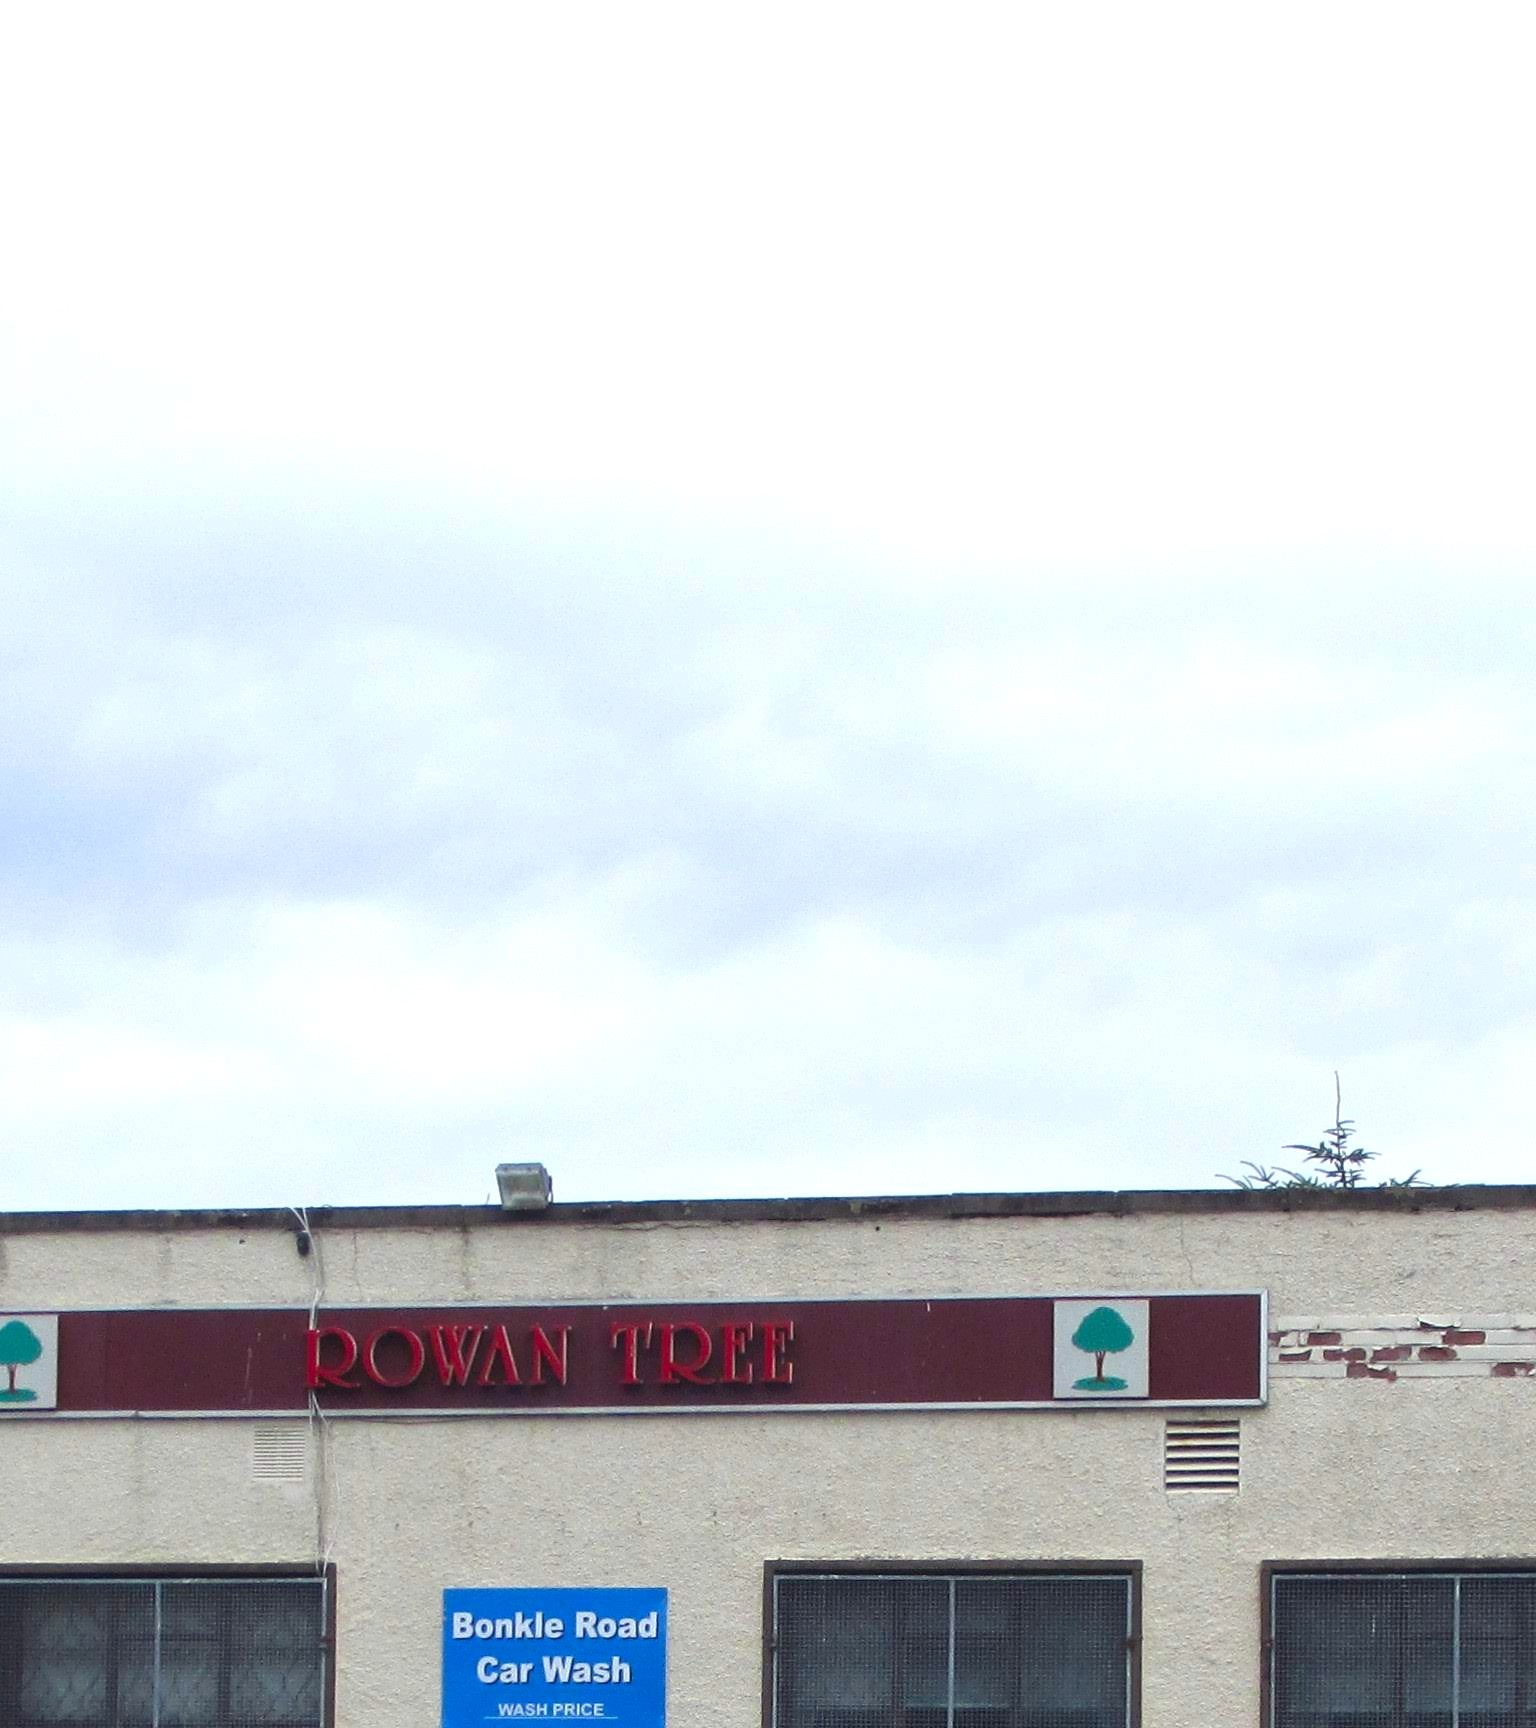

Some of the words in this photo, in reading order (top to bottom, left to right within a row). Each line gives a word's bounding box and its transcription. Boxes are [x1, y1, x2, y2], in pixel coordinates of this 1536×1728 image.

[305, 1324, 573, 1390] ROWAN
[611, 1320, 795, 1385] TREE
[452, 1612, 565, 1640] Bonkle
[575, 1611, 658, 1639] Road
[477, 1656, 533, 1684] Car
[542, 1656, 631, 1684] Wash
[498, 1703, 547, 1717] WASH
[553, 1703, 604, 1716] PRICE
